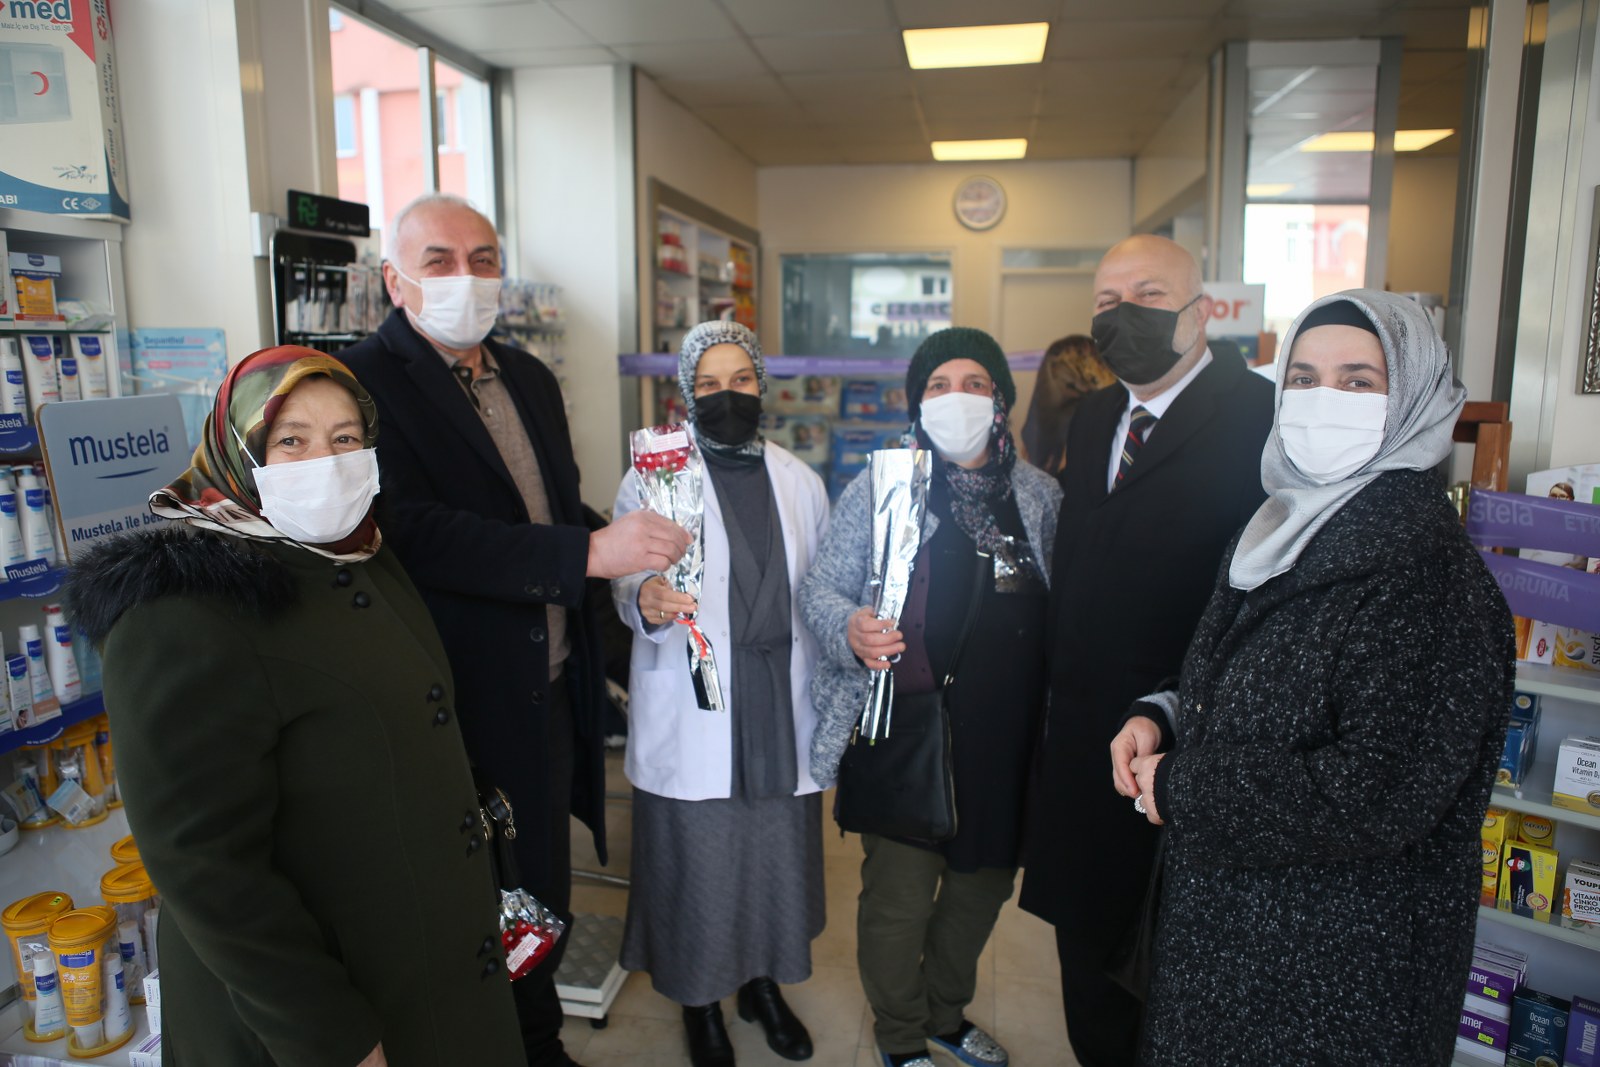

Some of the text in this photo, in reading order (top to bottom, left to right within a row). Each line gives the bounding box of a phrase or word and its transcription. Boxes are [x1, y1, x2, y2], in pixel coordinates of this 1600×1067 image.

[0, 194, 18, 205] ABI
[1212, 299, 1247, 320] or
[0, 418, 22, 429] stela
[69, 429, 170, 466] Mustela
[1471, 498, 1600, 534] stela ETK
[71, 519, 124, 542] Mustela
[125, 516, 141, 529] ile
[8, 563, 48, 580] Mustela
[1576, 756, 1597, 769] Ocean
[1574, 904, 1600, 913] PROPO
[1470, 971, 1489, 985] mer
[1461, 1014, 1483, 1030] umer
[1529, 1012, 1550, 1026] Ocean
[1531, 1023, 1546, 1035] Plus
